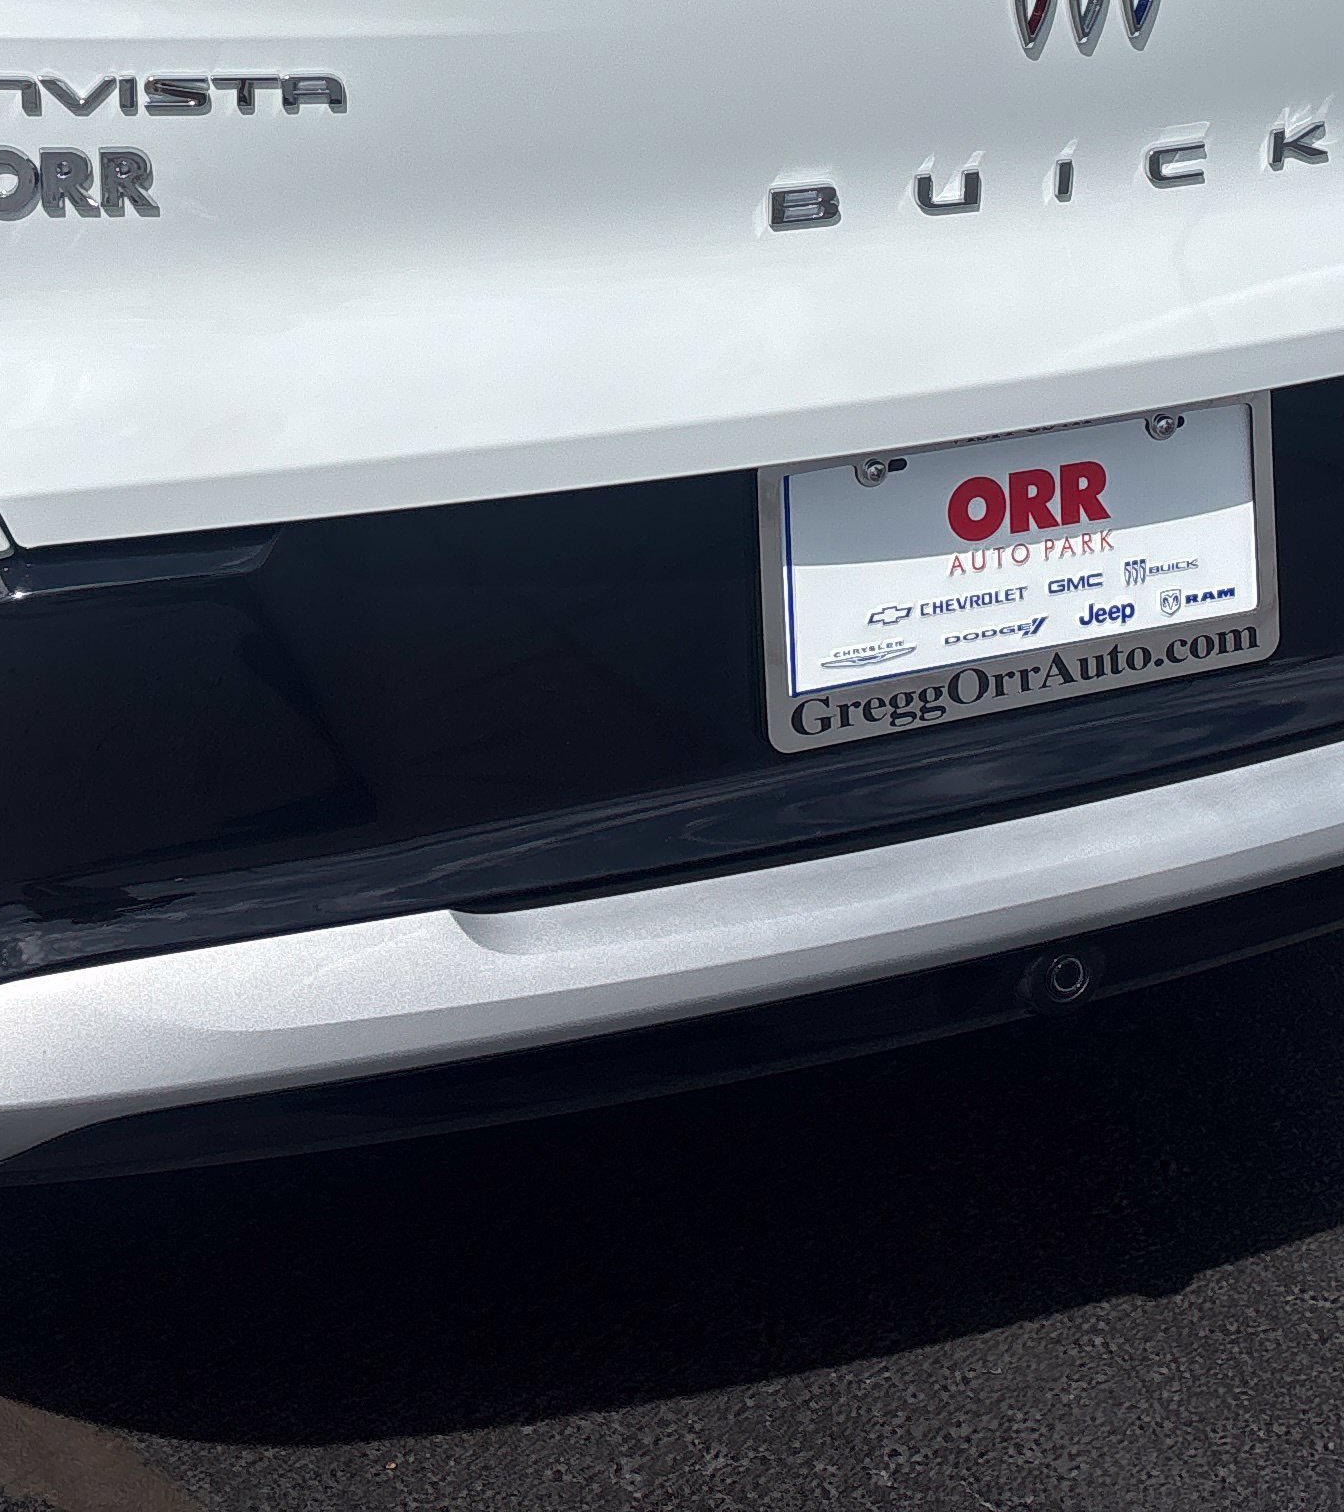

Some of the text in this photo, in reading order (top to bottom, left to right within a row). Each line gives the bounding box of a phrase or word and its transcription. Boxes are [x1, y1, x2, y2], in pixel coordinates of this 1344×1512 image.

[768, 120, 1329, 232] BUICK
[947, 461, 1111, 542] ORR
[948, 529, 1115, 577] AUTO PARK
[1148, 558, 1199, 576] BUICK
[1048, 572, 1104, 595] GMC
[1185, 587, 1236, 604] RAM
[920, 586, 1028, 616] CHEVROLET
[1079, 602, 1136, 626] Jeep
[944, 622, 1032, 646] DODGE
[833, 640, 905, 658] CHRYSLER
[791, 625, 1261, 736] GreggOrrAuto.com
